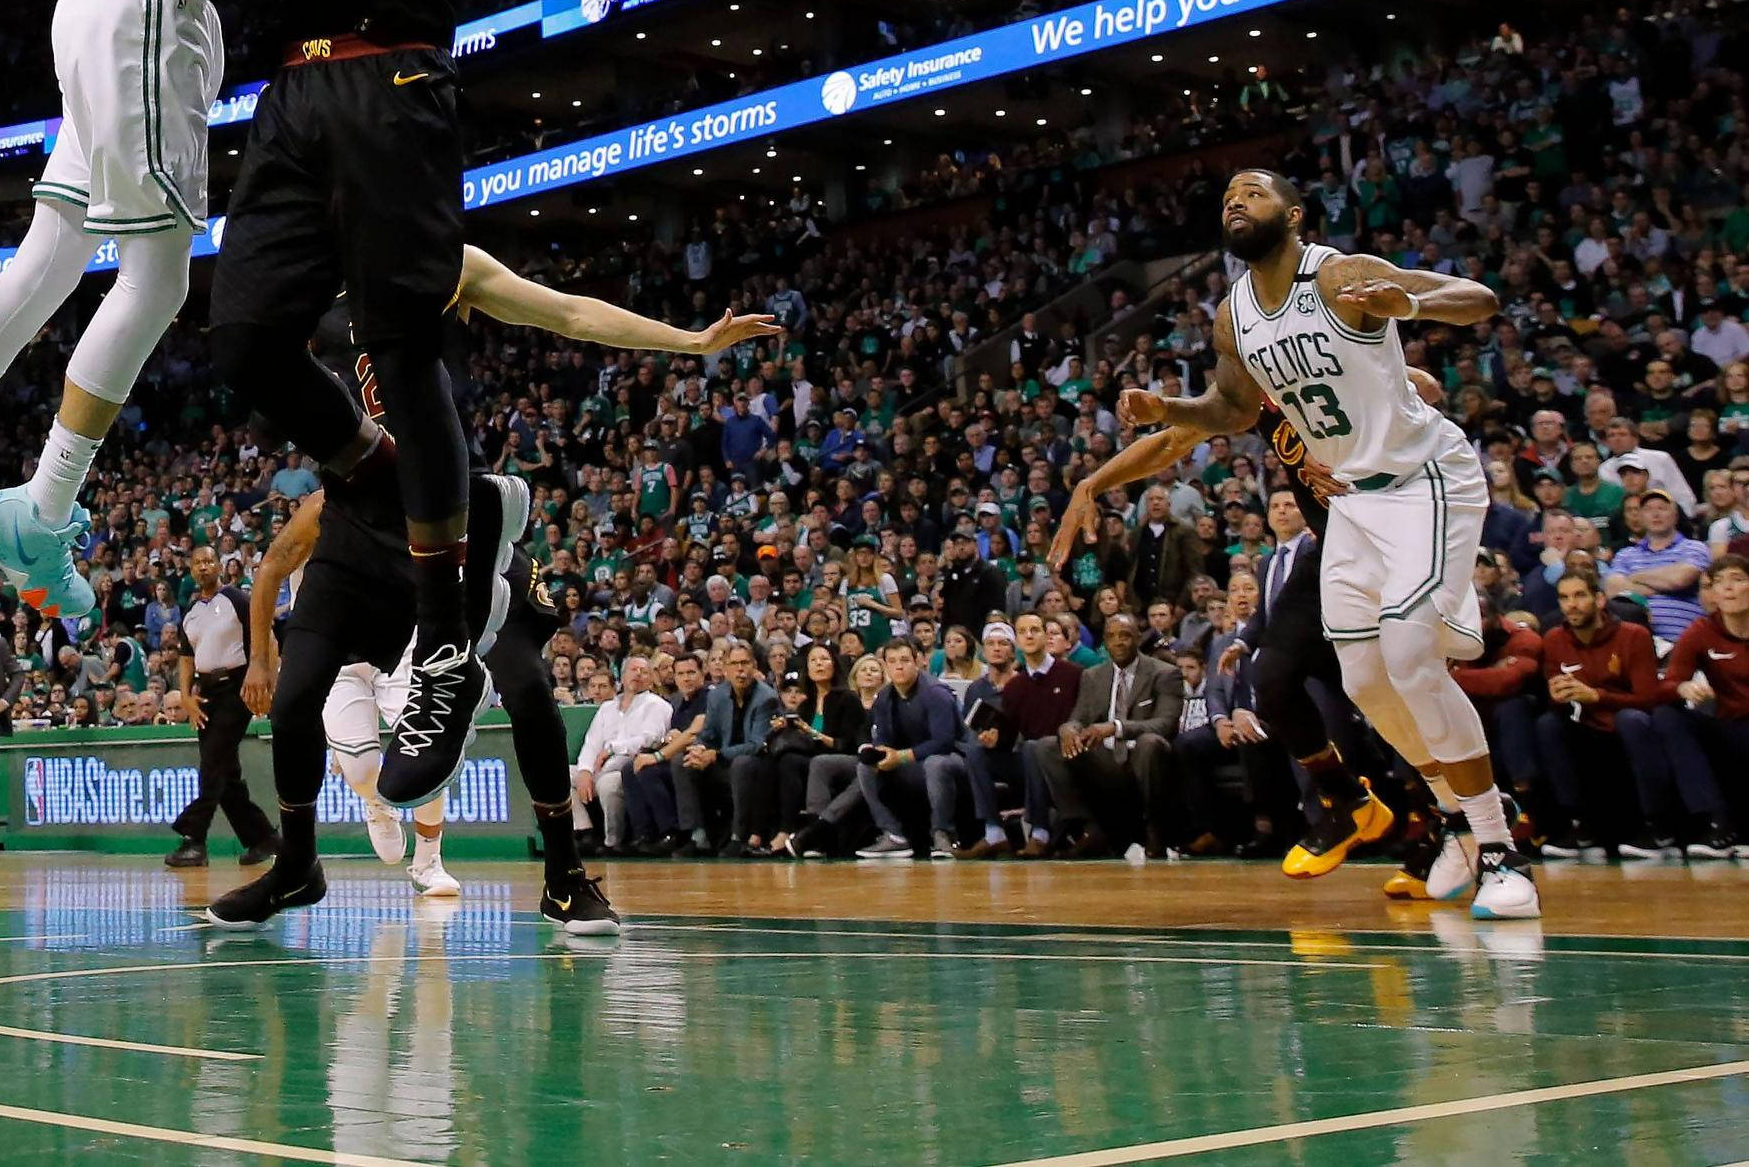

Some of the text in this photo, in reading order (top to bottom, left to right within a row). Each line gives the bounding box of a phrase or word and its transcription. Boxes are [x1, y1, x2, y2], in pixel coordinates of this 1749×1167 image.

[302, 38, 332, 61] CAVS
[1031, 16, 1083, 54] We
[858, 47, 983, 92] Safety Insurance
[481, 162, 521, 204] you
[528, 138, 620, 183] manage
[628, 118, 684, 160] life's
[690, 100, 777, 144] storms
[1248, 332, 1344, 391] CELTICS
[1281, 384, 1352, 439] 13
[45, 755, 201, 825] NBAStore.com
